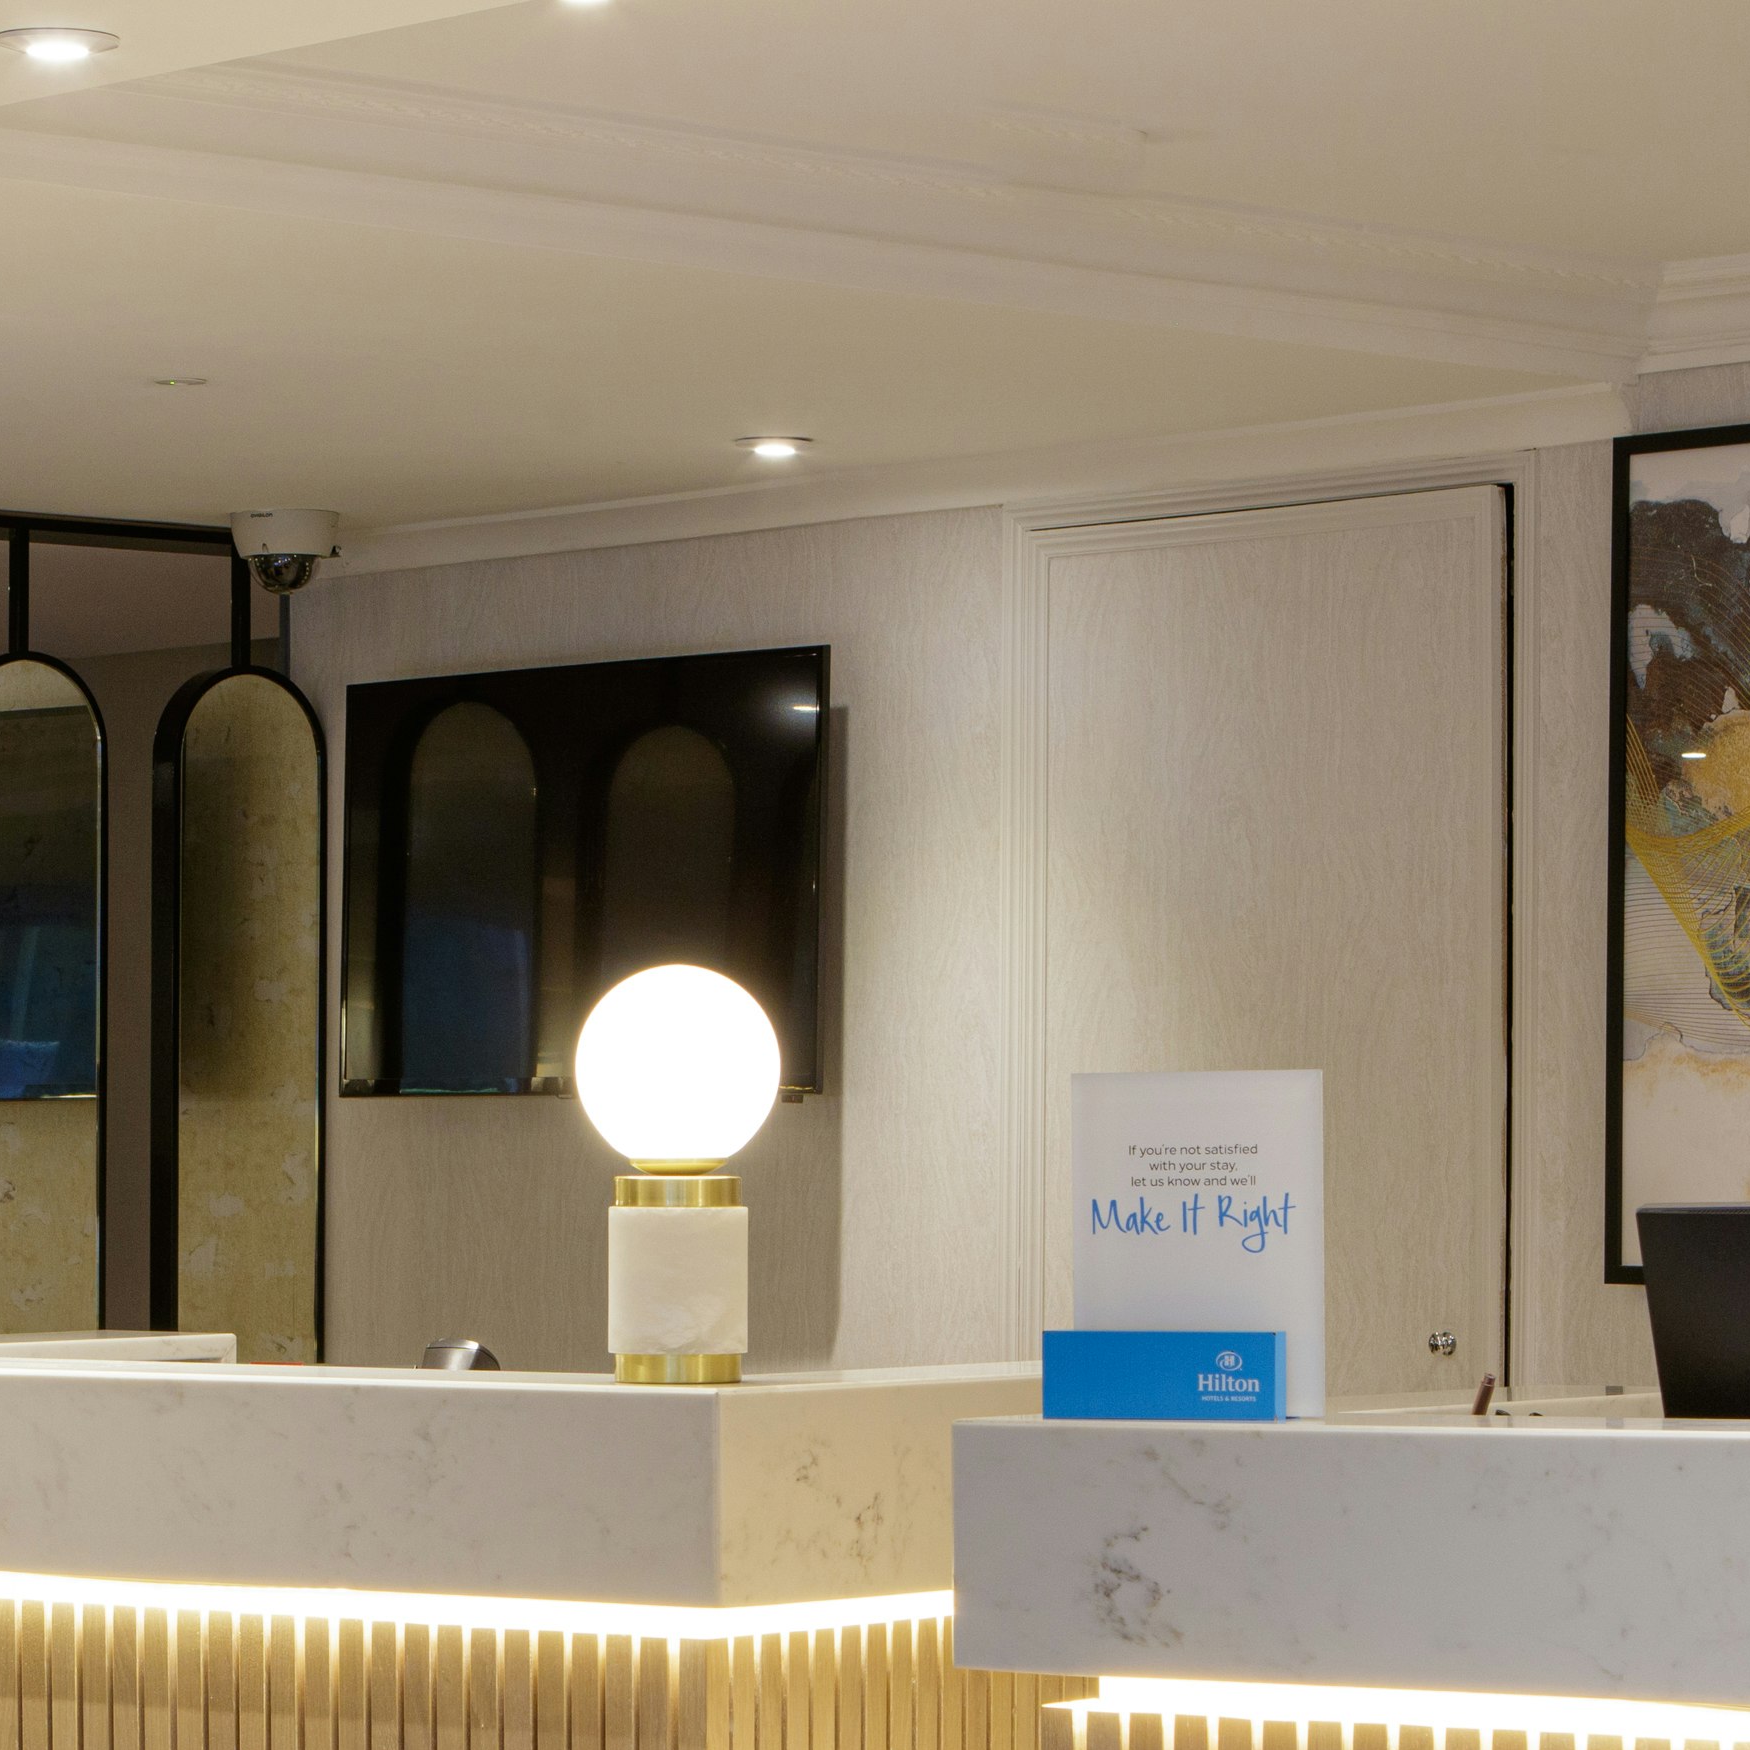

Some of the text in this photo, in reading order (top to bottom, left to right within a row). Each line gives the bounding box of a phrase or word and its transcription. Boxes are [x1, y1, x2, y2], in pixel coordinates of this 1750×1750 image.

[1128, 1144, 1258, 1158] If you're not satisfied
[1149, 1161, 1176, 1171] with
[1179, 1162, 1207, 1173] your
[1131, 1175, 1256, 1187] let us know and we'll
[1092, 1192, 1296, 1253] Make It Right
[1198, 1374, 1260, 1392] Hilton
